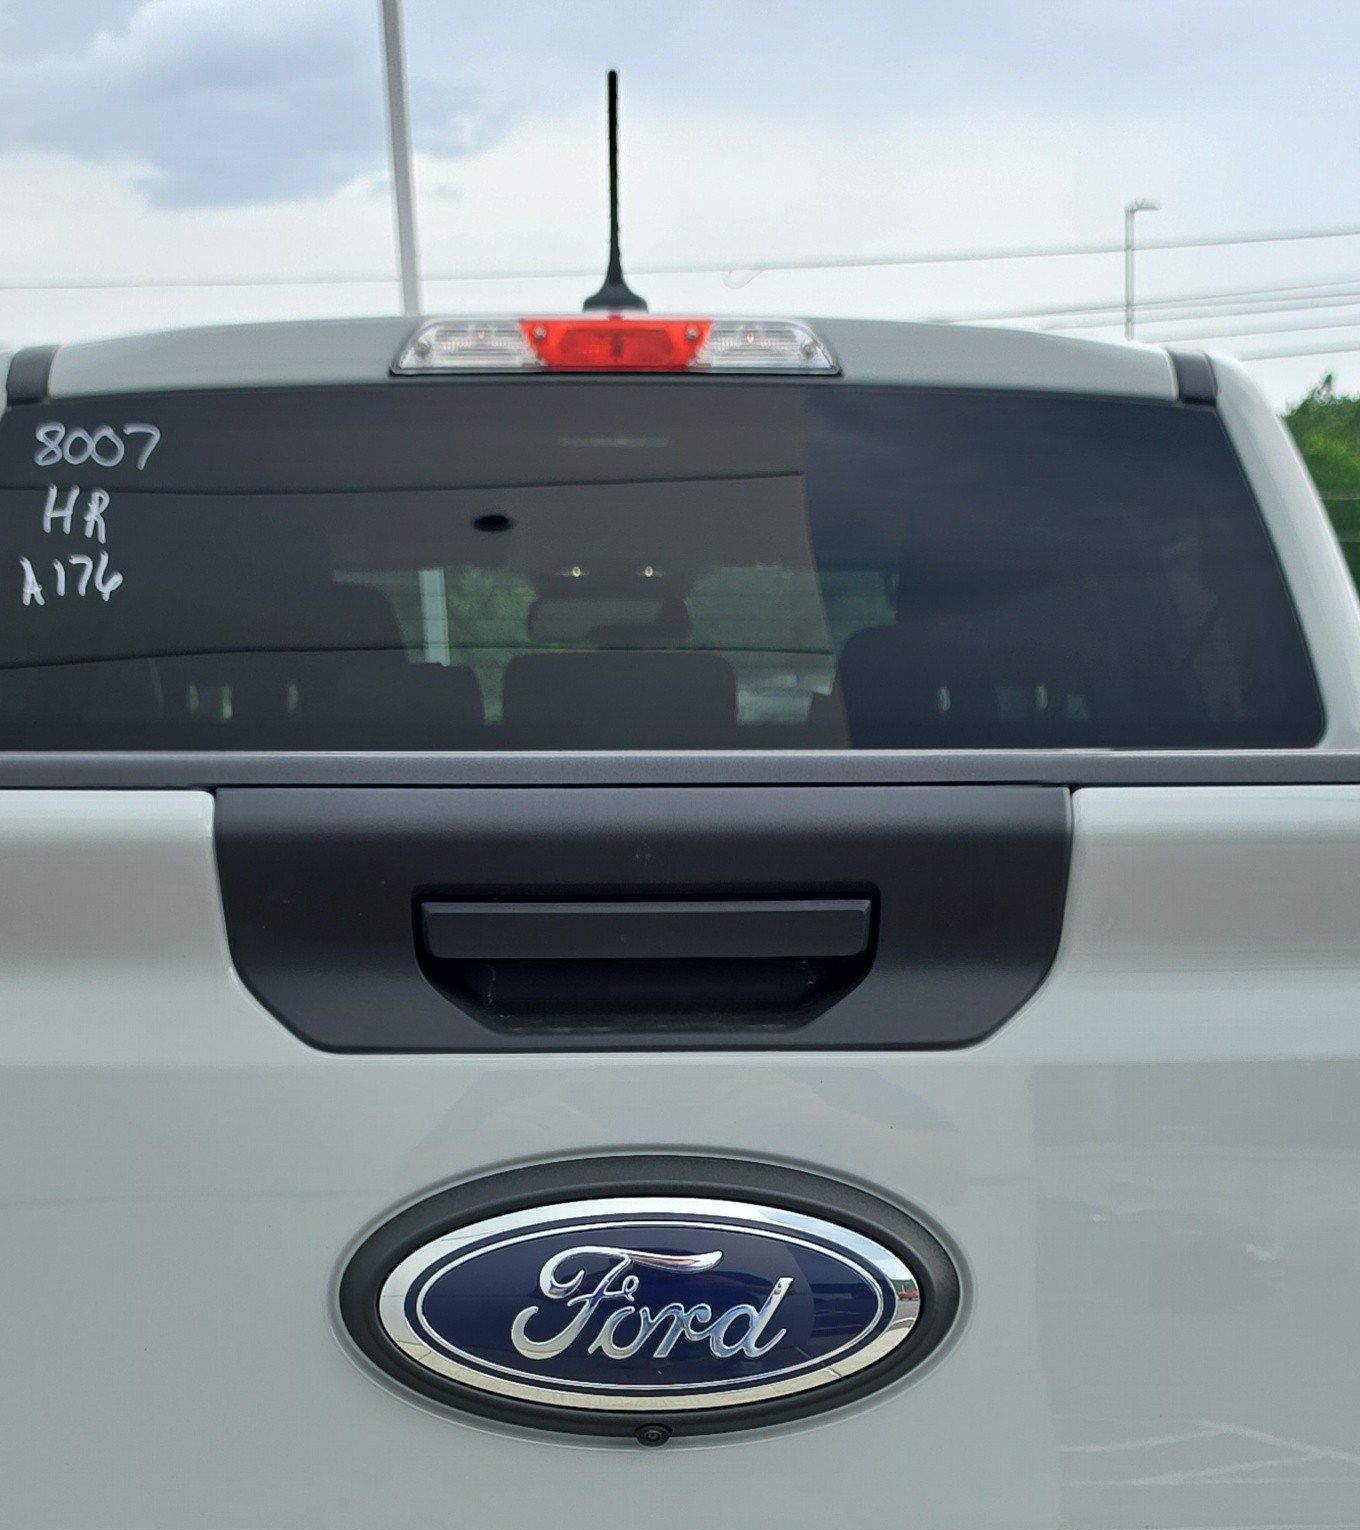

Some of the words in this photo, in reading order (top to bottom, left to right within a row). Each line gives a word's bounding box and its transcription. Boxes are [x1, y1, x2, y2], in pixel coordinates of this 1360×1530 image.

[34, 421, 162, 471] 8007
[42, 483, 110, 543] HR
[19, 550, 123, 606] A176
[511, 1245, 794, 1360] Ford
